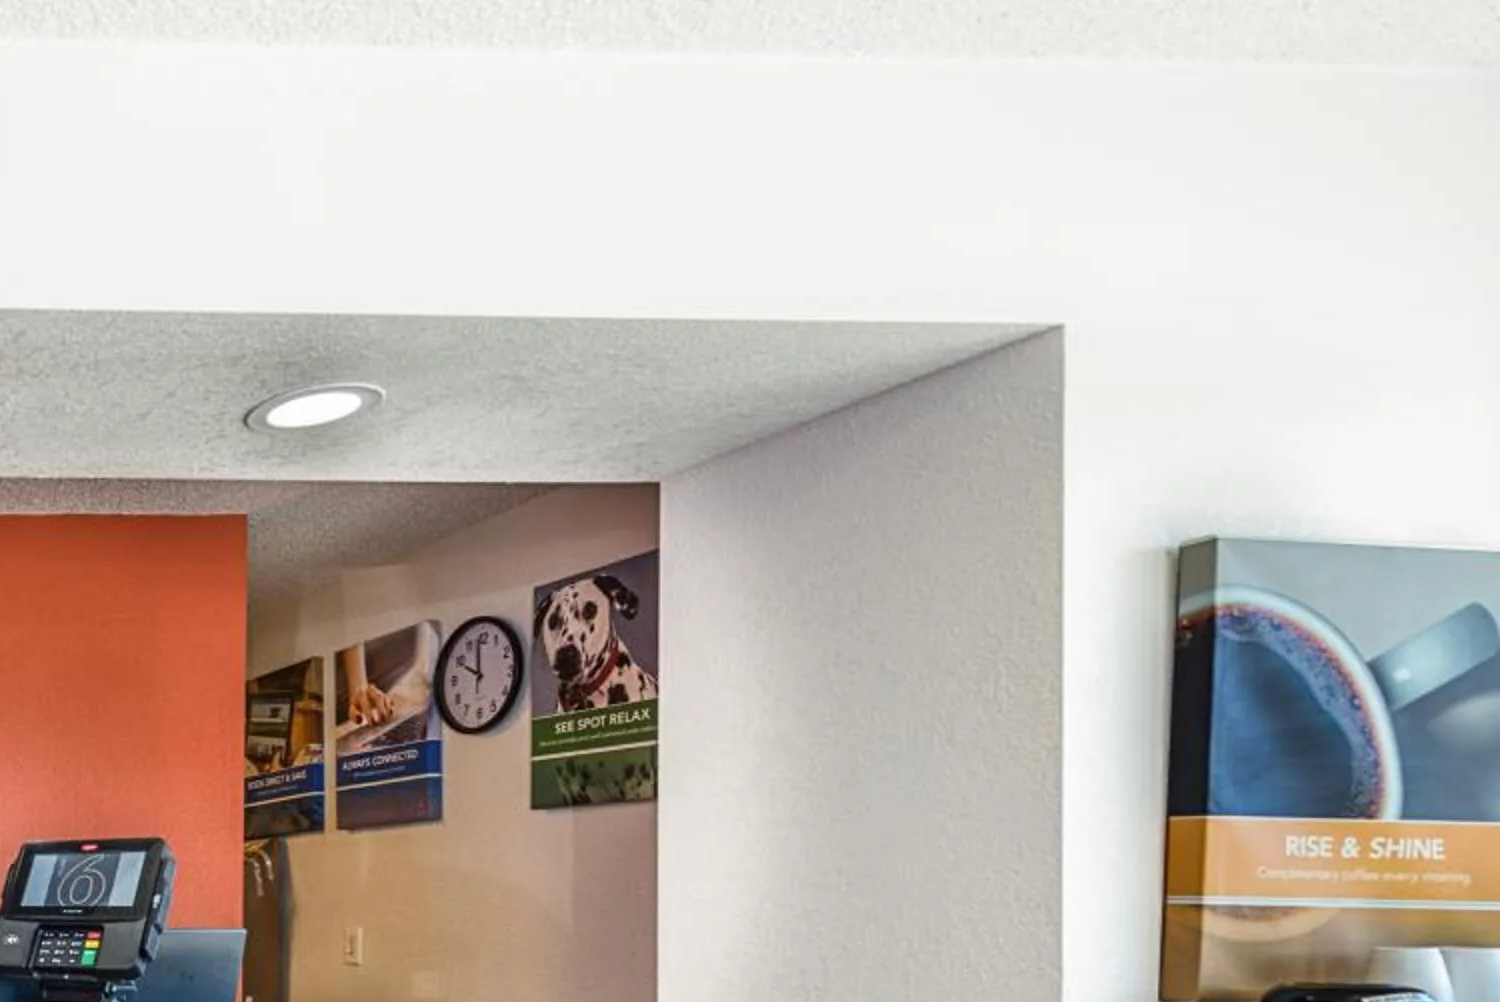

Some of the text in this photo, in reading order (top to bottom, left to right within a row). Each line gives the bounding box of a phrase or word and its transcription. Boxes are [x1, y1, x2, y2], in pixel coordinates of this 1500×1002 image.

[554, 707, 651, 735] SEE SPOT RELAX
[341, 756, 371, 772] ALWAYS
[1285, 835, 1446, 861] RISE & SHINE
[57, 854, 107, 906] 6
